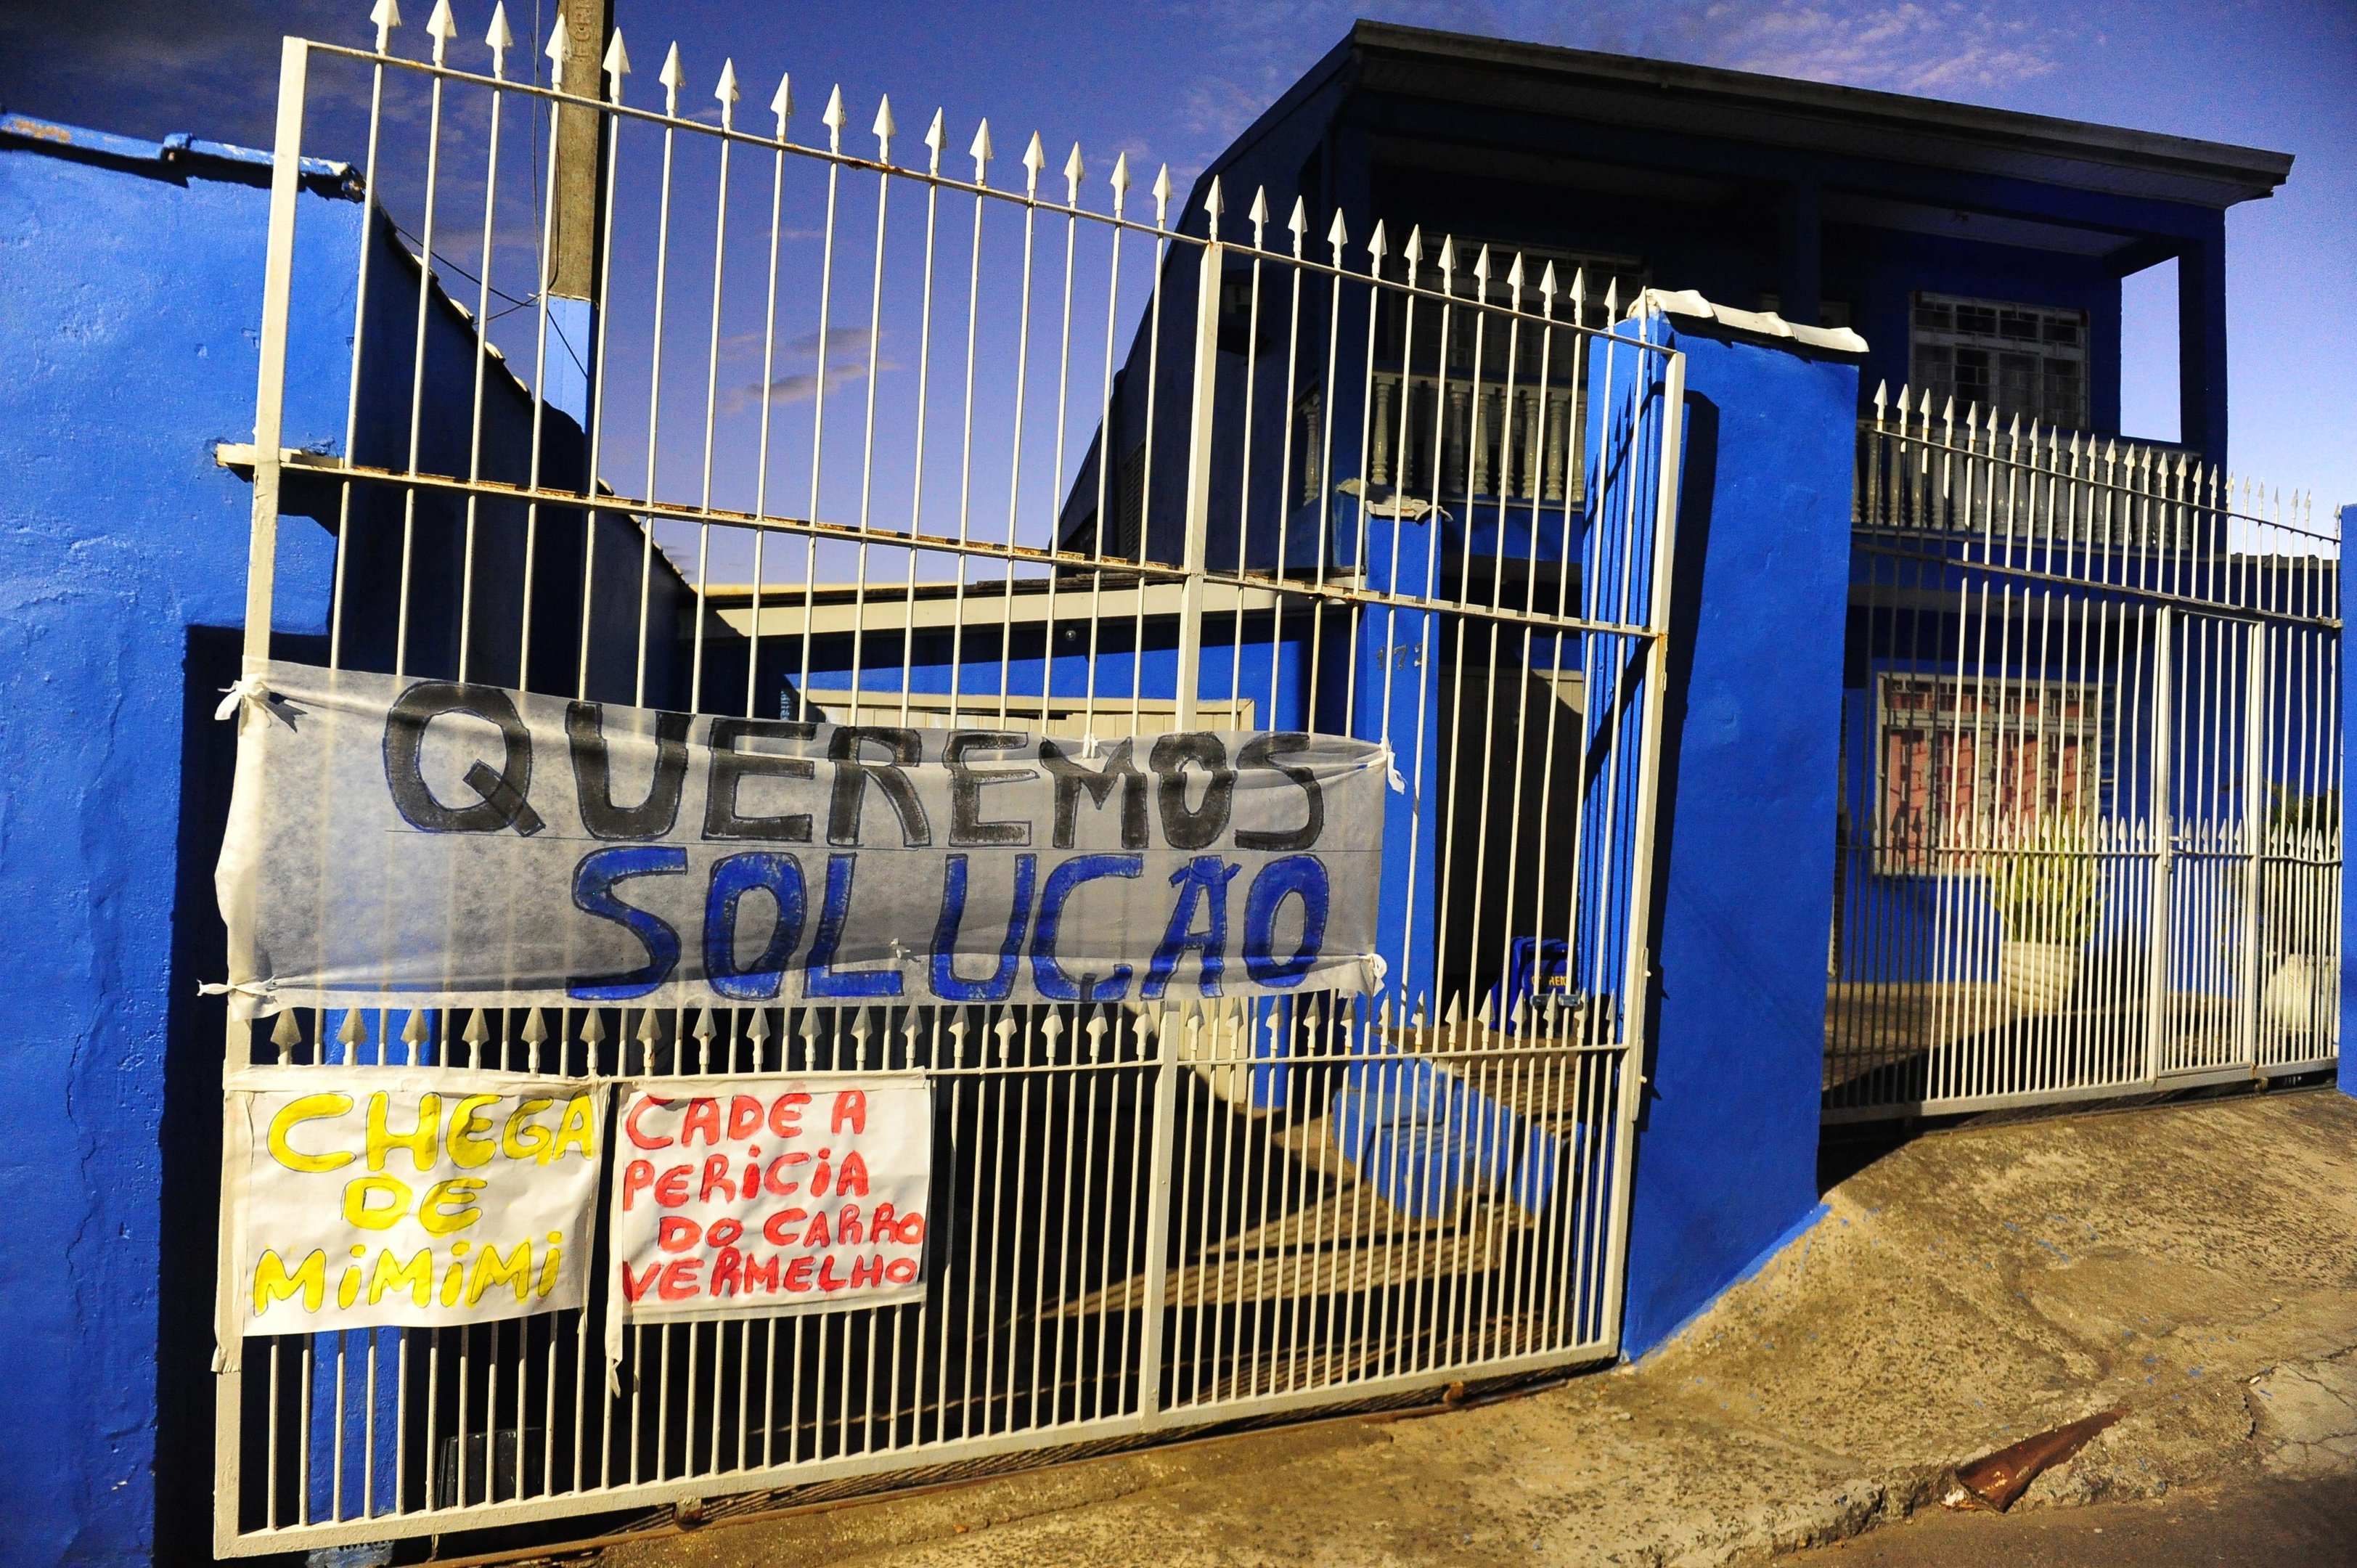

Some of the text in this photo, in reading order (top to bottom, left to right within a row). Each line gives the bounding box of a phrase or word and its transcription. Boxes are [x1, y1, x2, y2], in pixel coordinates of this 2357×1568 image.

[385, 681, 1323, 850] QUEREMOS
[267, 1090, 594, 1172] CHEGA
[831, 1090, 867, 1135] A
[341, 1175, 487, 1238] DE
[658, 1202, 925, 1253] DO CARRO
[622, 1246, 918, 1302] VERMELHO
